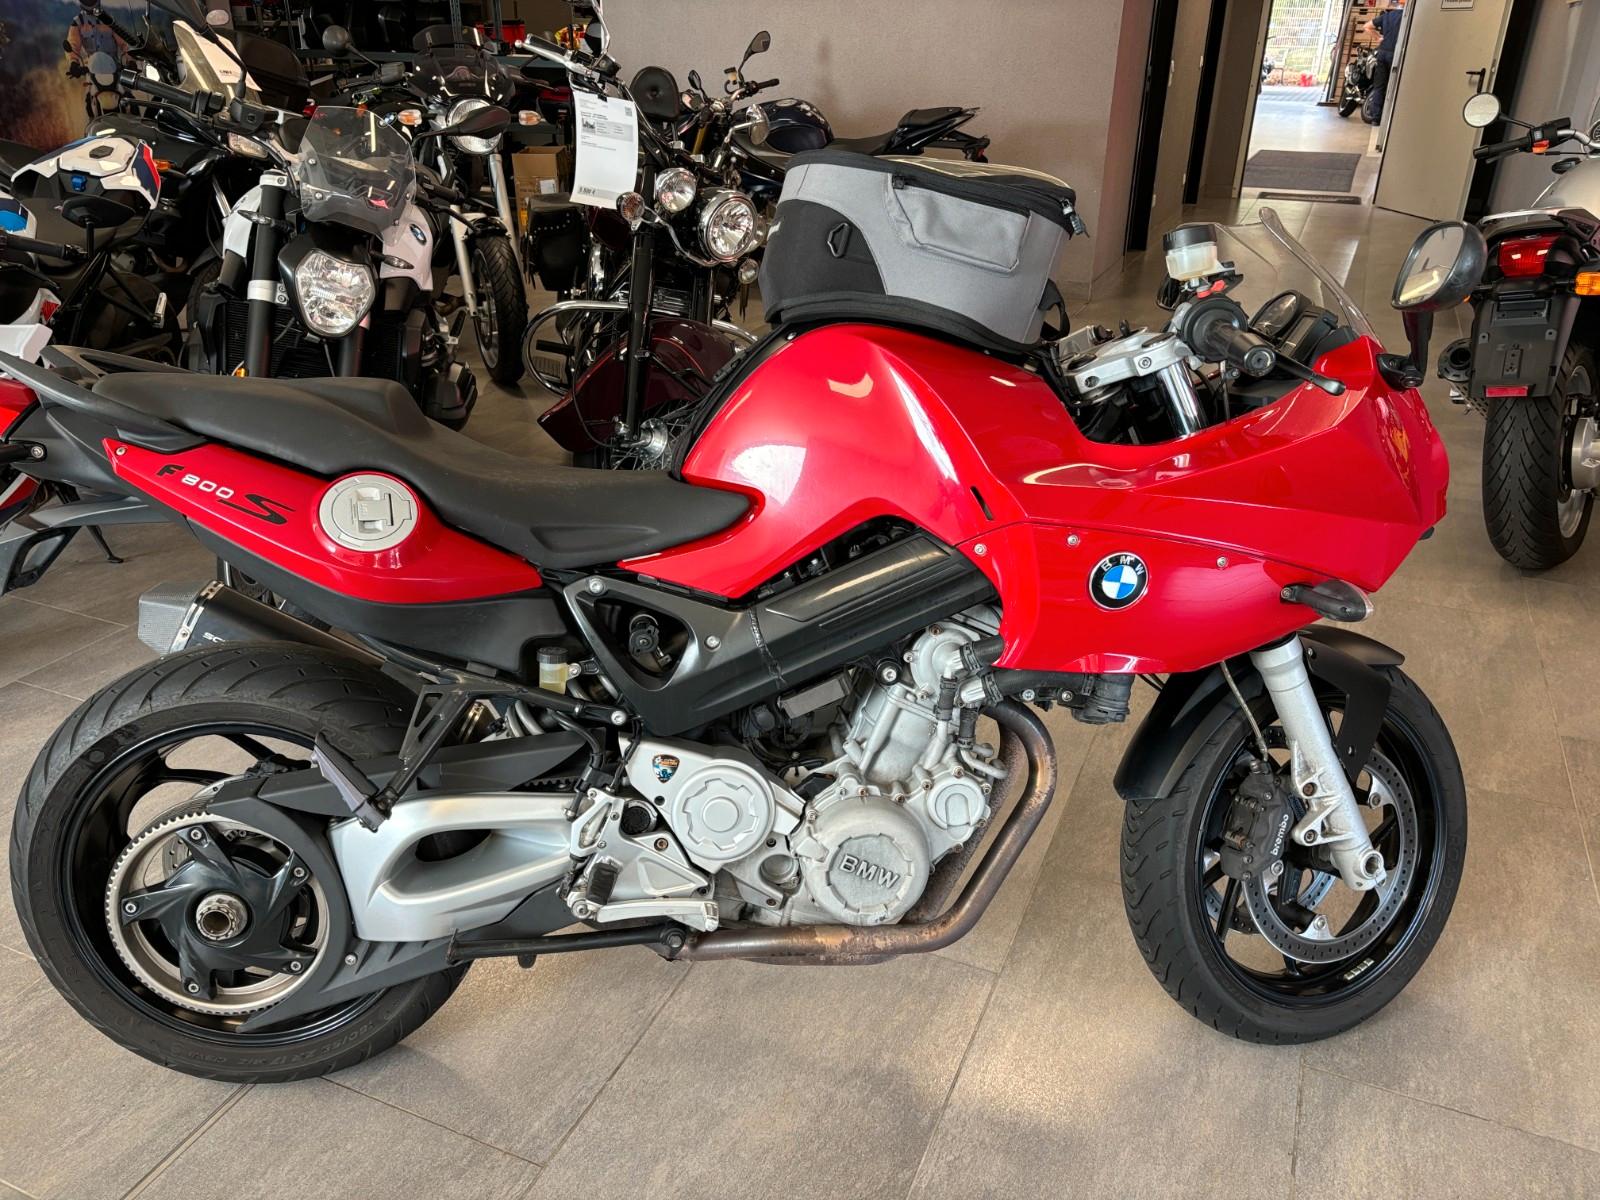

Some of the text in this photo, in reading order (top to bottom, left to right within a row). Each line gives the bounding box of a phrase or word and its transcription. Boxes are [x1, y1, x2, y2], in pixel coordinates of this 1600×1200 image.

[156, 464, 297, 526] F 800 S
[1100, 555, 1146, 577] BMW
[1270, 813, 1290, 857] brembo
[839, 853, 901, 889] BMW
